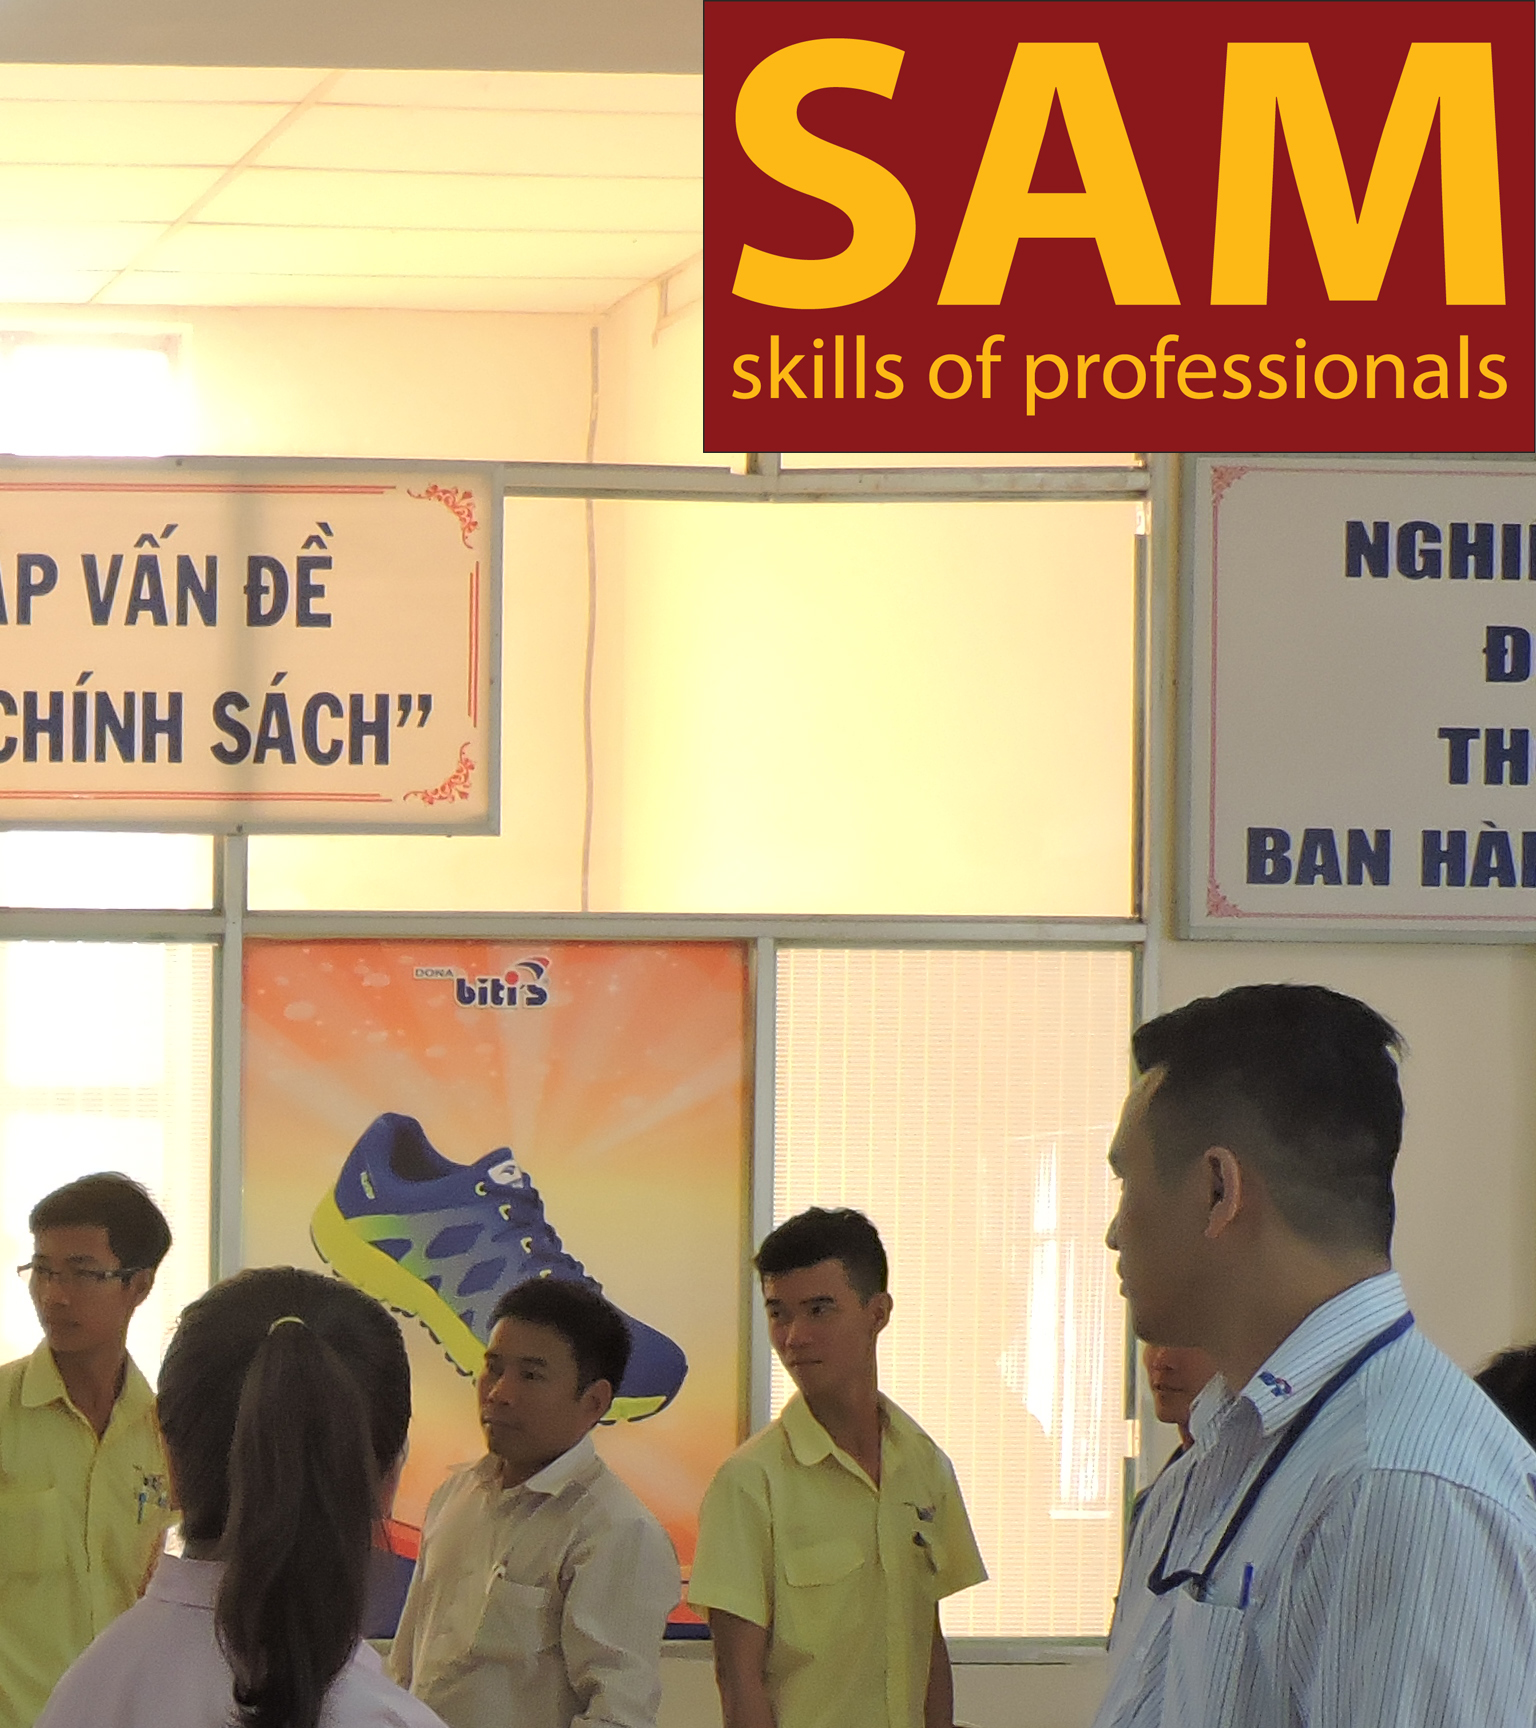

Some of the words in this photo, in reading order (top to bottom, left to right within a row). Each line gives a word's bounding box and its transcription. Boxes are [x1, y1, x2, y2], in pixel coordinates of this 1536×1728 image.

[82, 522, 218, 627] VẤN
[242, 521, 334, 628] ĐỀ
[1345, 518, 1536, 582] NGHI
[210, 671, 435, 766] SÁCH”
[1245, 825, 1393, 888] BAN
